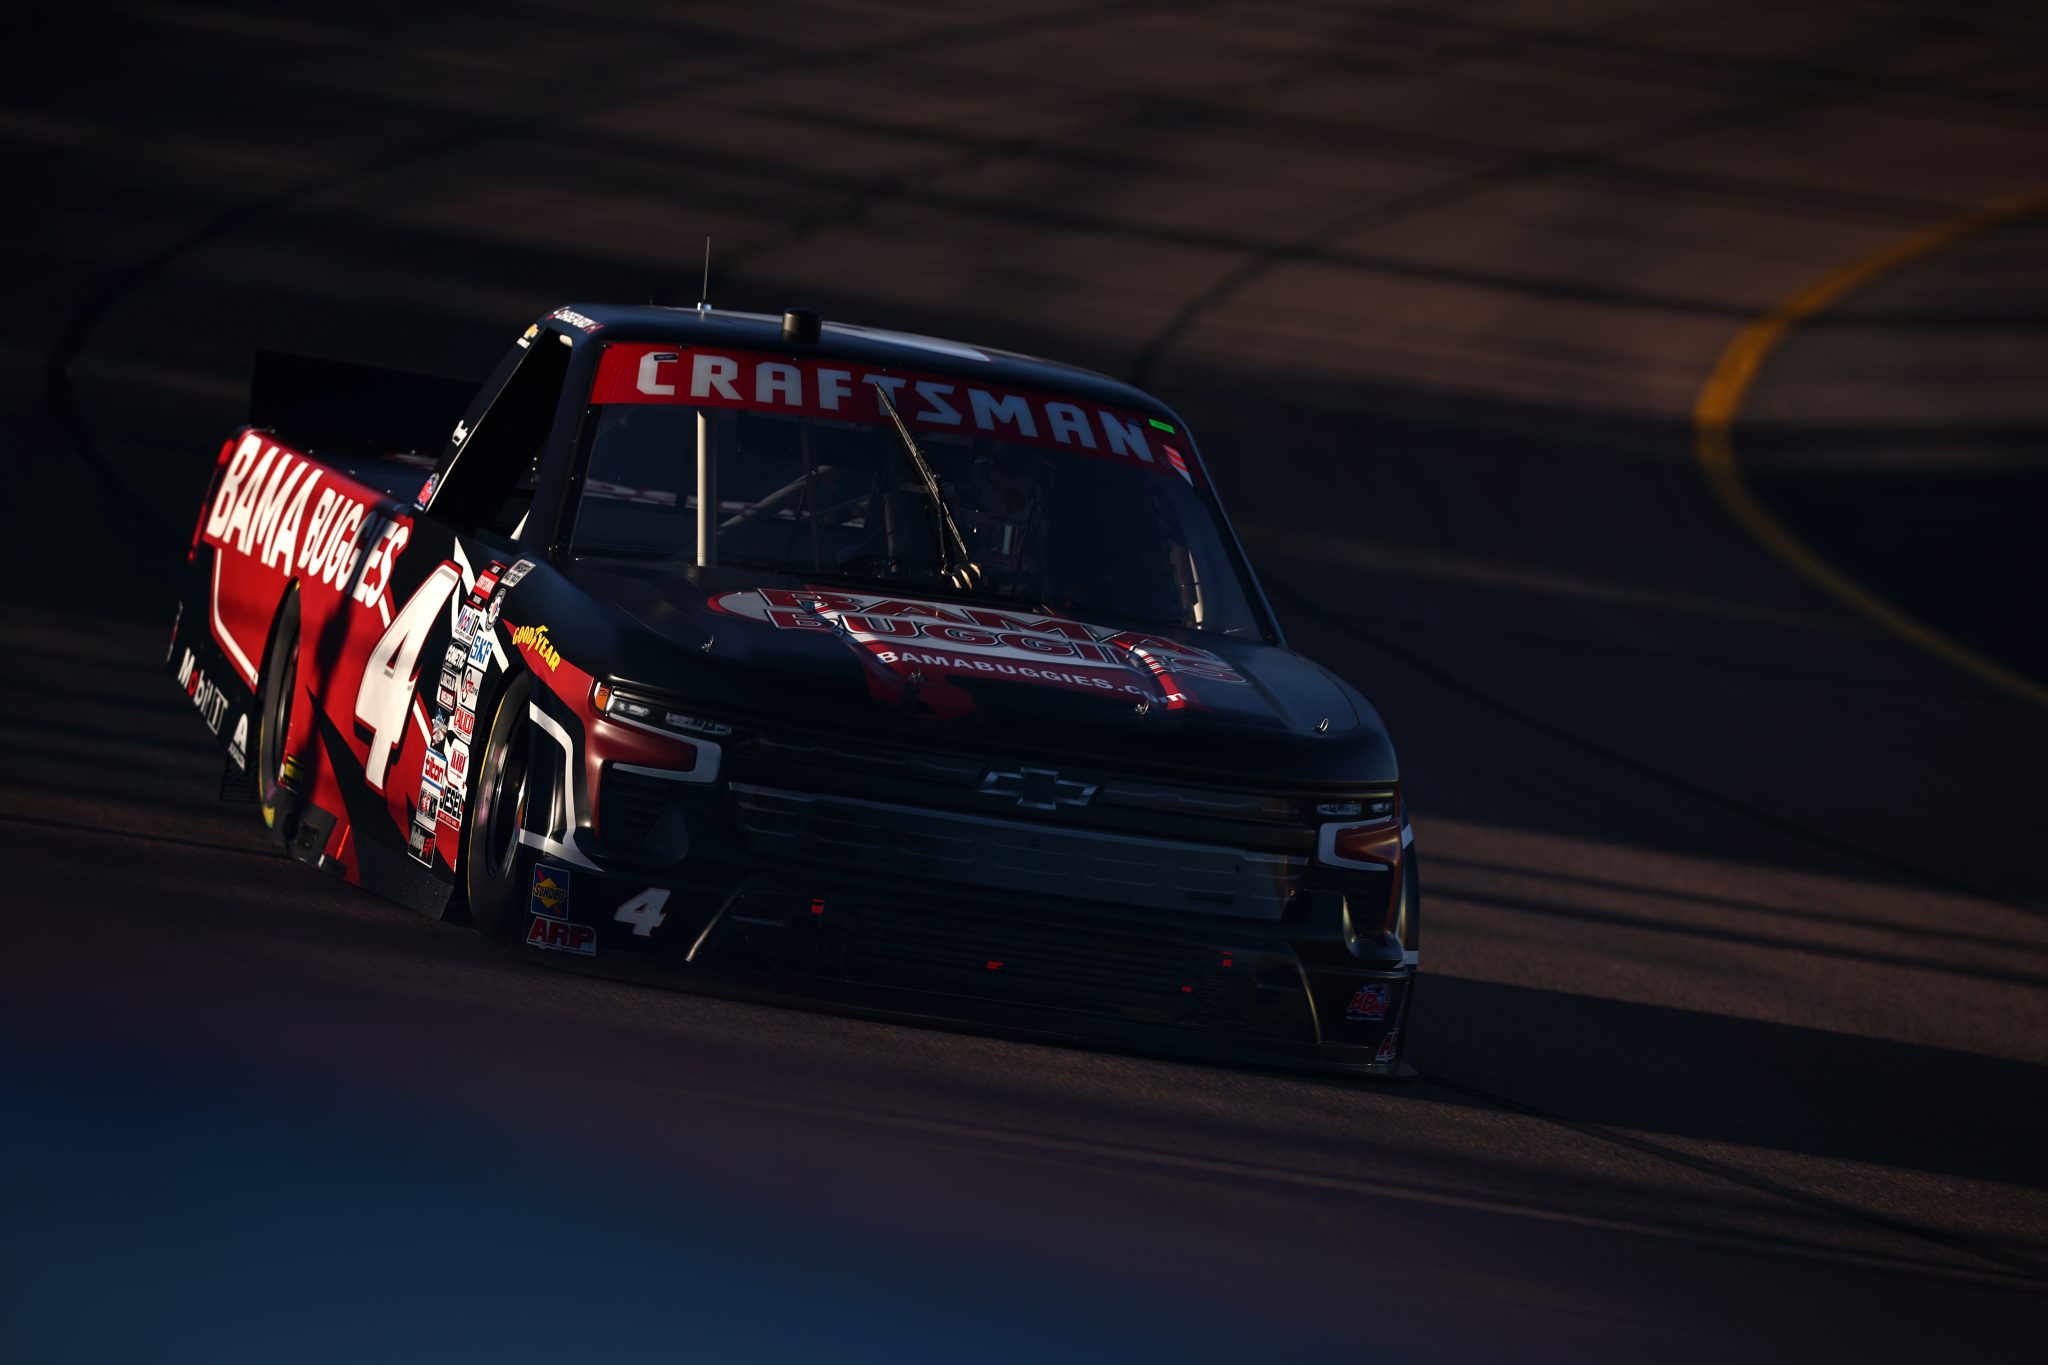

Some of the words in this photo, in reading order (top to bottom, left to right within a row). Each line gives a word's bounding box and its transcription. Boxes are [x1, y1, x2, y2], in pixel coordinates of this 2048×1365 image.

[636, 352, 1154, 463] CRAFTSMAN
[206, 433, 324, 577] BAMA
[297, 487, 410, 608] BUGGIES
[470, 635, 493, 665] SKF
[512, 624, 561, 672] GOODYEAR
[747, 588, 1224, 662] BAMA
[355, 561, 461, 791] 4
[453, 707, 476, 736] CALICO
[527, 917, 595, 950] ARP
[614, 887, 672, 938] 4
